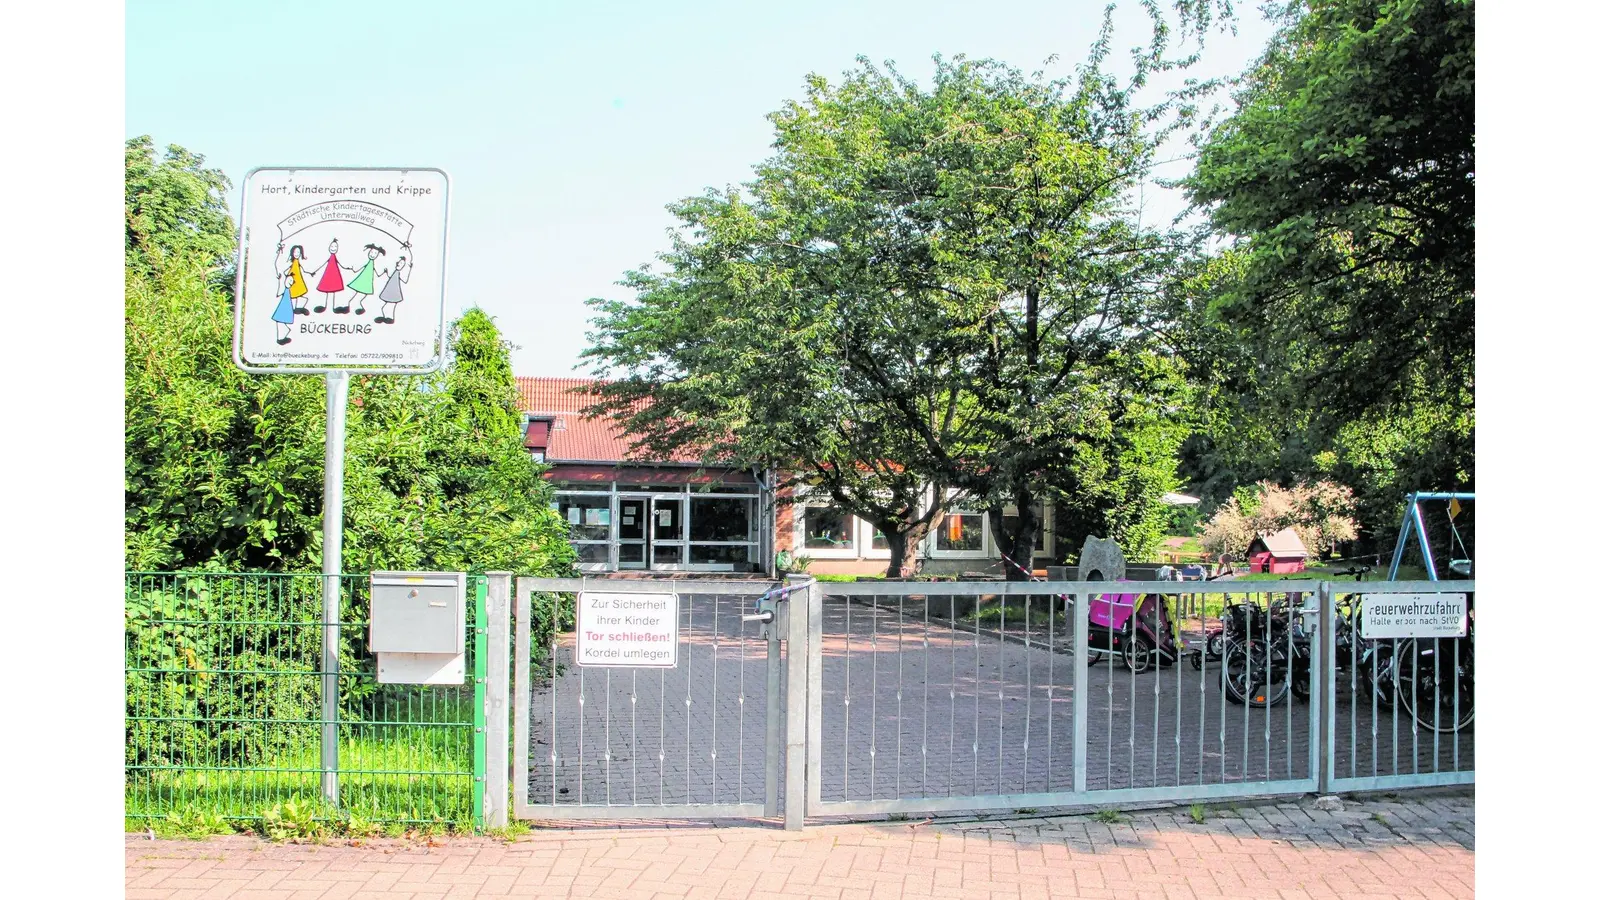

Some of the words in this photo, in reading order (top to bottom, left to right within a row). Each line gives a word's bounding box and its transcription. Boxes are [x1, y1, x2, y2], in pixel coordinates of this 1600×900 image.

[261, 185, 291, 195] Hort,
[295, 185, 366, 196] Kindergarten
[372, 185, 390, 194] und
[397, 186, 432, 197] Krippe
[287, 205, 330, 226] Städtische
[320, 211, 375, 225] Unterwallweg
[300, 322, 372, 334] BÜCKEBURG
[591, 599, 609, 608] Zur
[612, 600, 666, 609] Sicherheit
[597, 615, 621, 624] ihrer
[625, 616, 659, 625] Kinder
[1420, 616, 1438, 624] nach
[1441, 616, 1459, 624] StVO
[586, 631, 604, 640] Tor
[608, 632, 670, 641] schließen!
[585, 648, 620, 657] Kordel
[623, 649, 670, 660] umlegen
